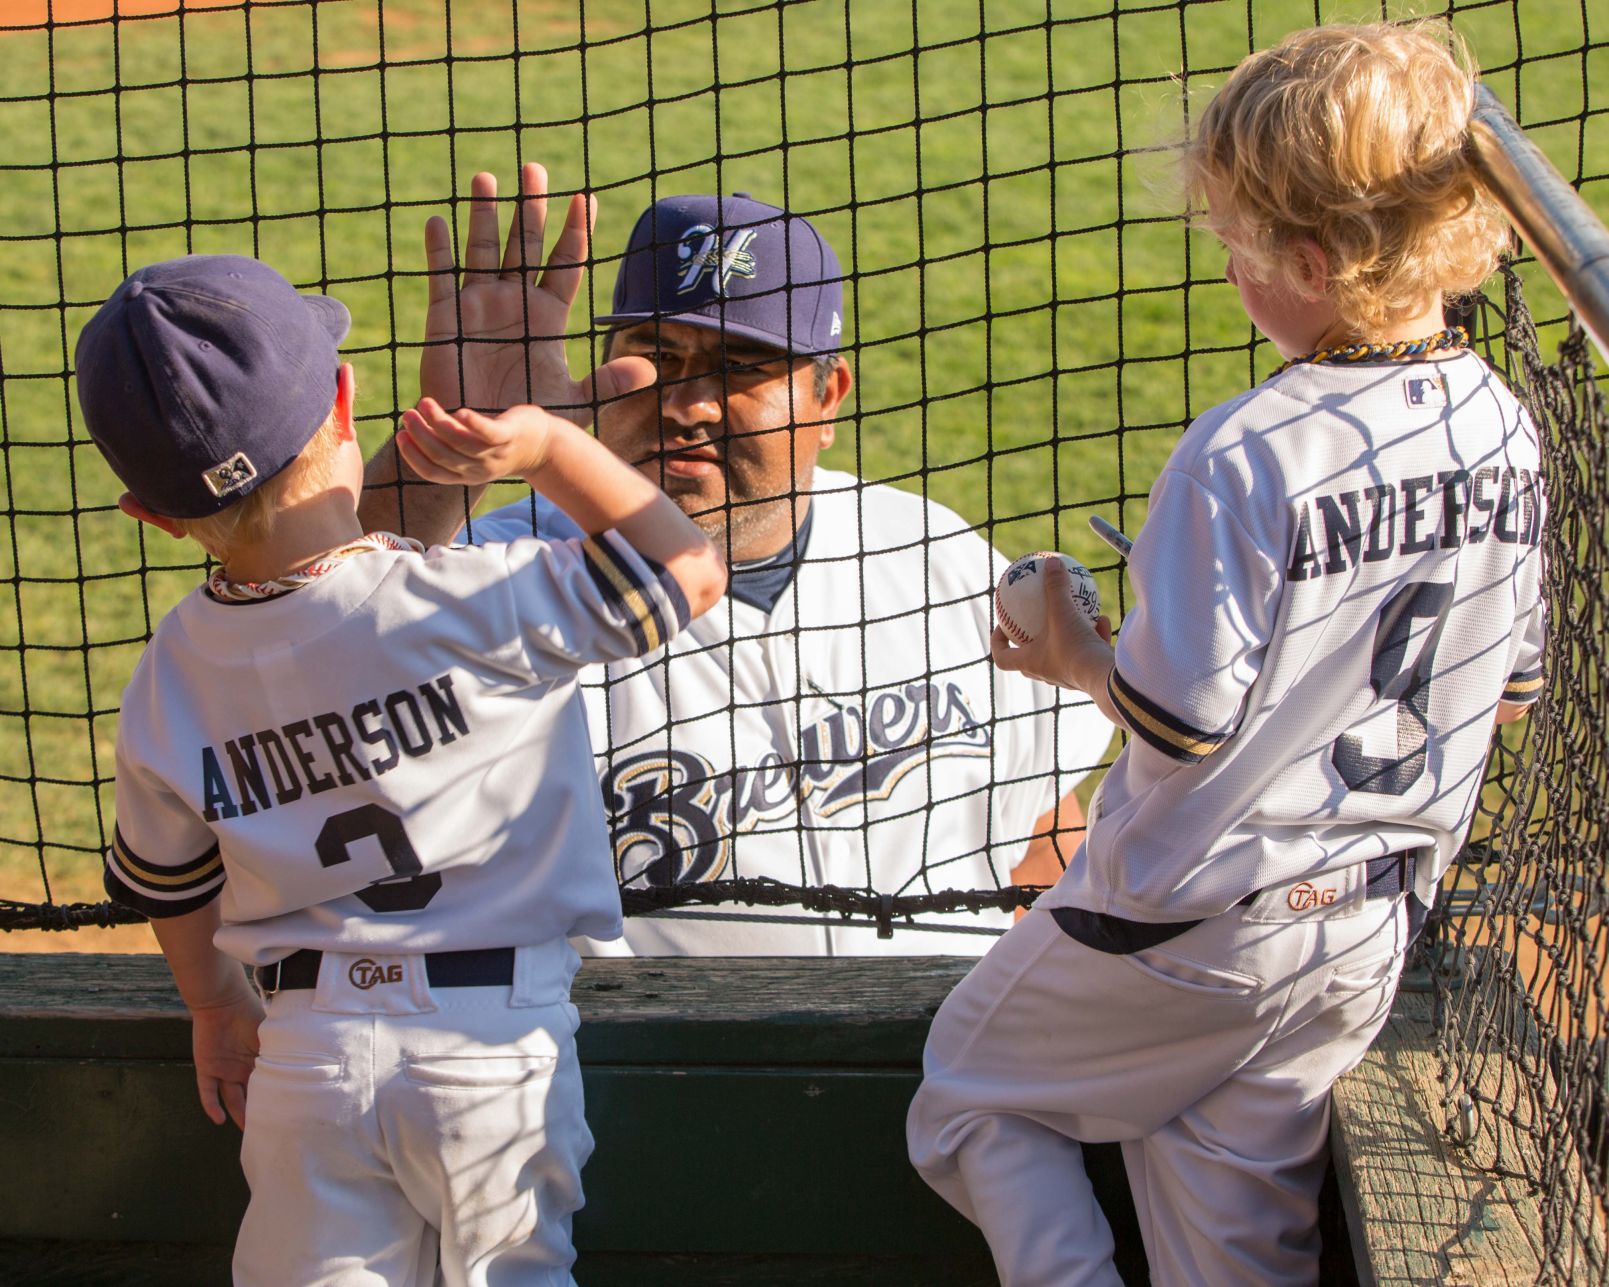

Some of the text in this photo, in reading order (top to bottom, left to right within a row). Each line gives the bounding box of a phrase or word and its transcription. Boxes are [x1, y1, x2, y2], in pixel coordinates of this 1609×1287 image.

[202, 674, 470, 822] ANDERSON
[600, 682, 990, 887] Brewers
[314, 803, 442, 913] 3
[1289, 883, 1337, 909] TAG
[350, 960, 403, 988] TAG
